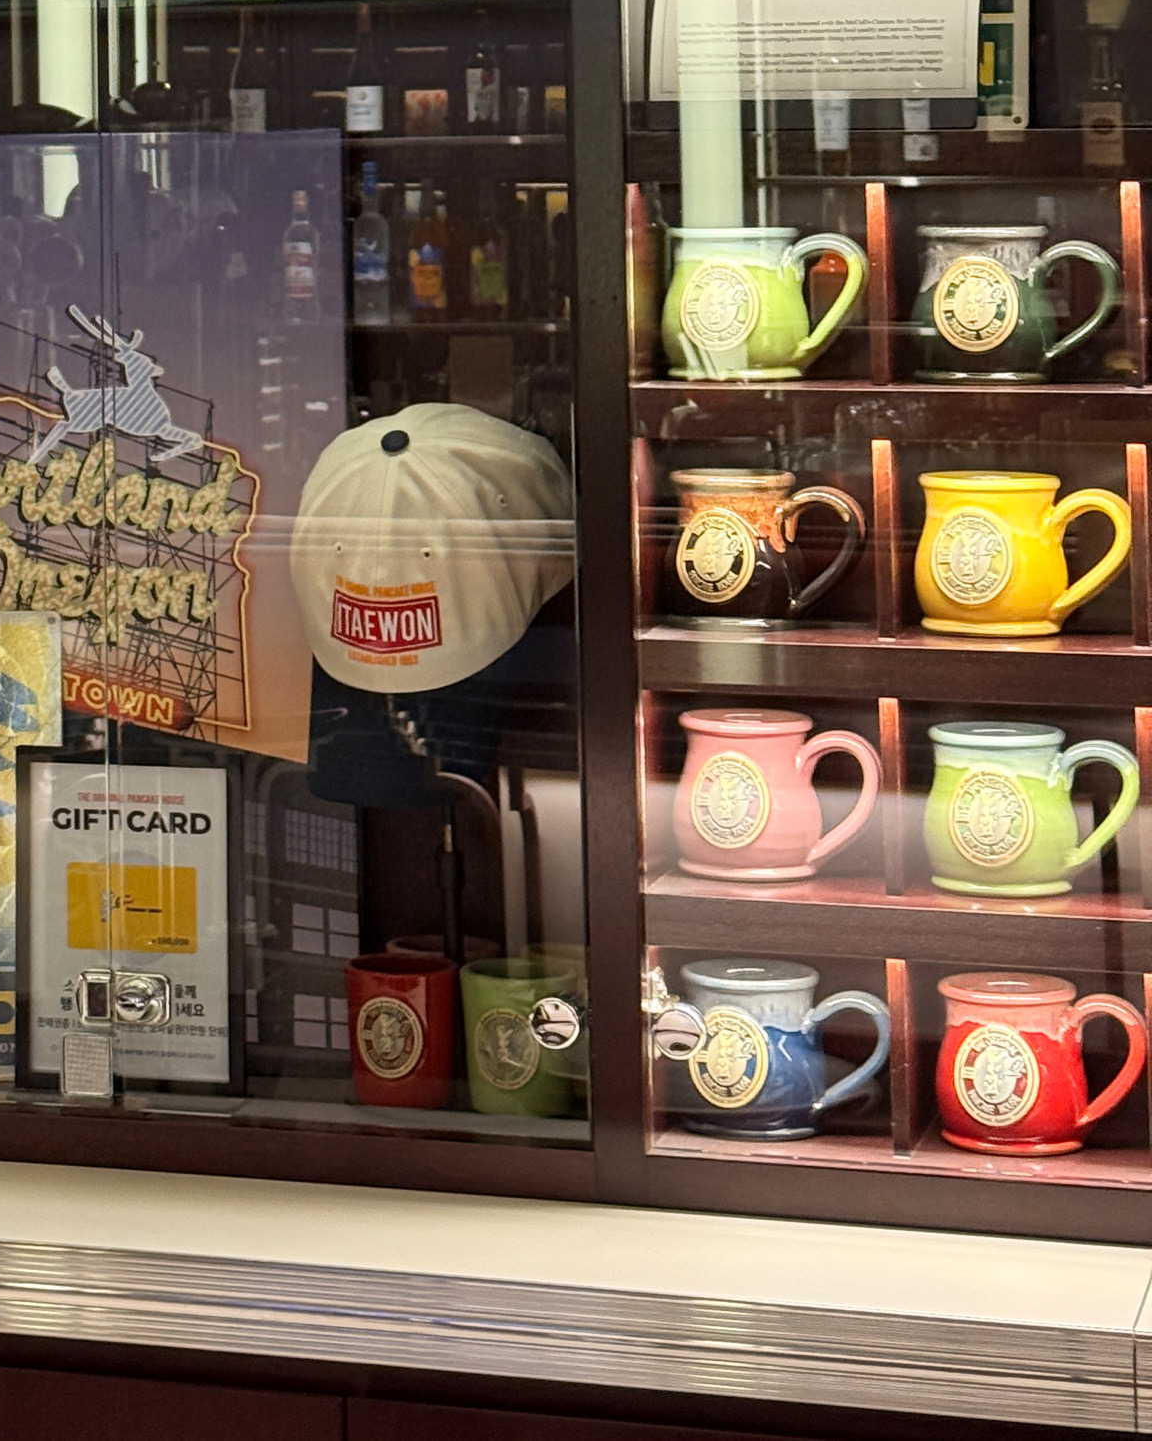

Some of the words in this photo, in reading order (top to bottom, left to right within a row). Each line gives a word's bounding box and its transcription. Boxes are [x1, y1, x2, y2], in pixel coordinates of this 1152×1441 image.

[337, 602, 434, 643] ITAEWON
[62, 672, 174, 725] TOWN
[78, 792, 92, 803] THE
[162, 794, 186, 806] HOUSE
[51, 808, 122, 831] GIFT
[126, 810, 211, 835] CARD
[175, 1002, 205, 1017] 세요
